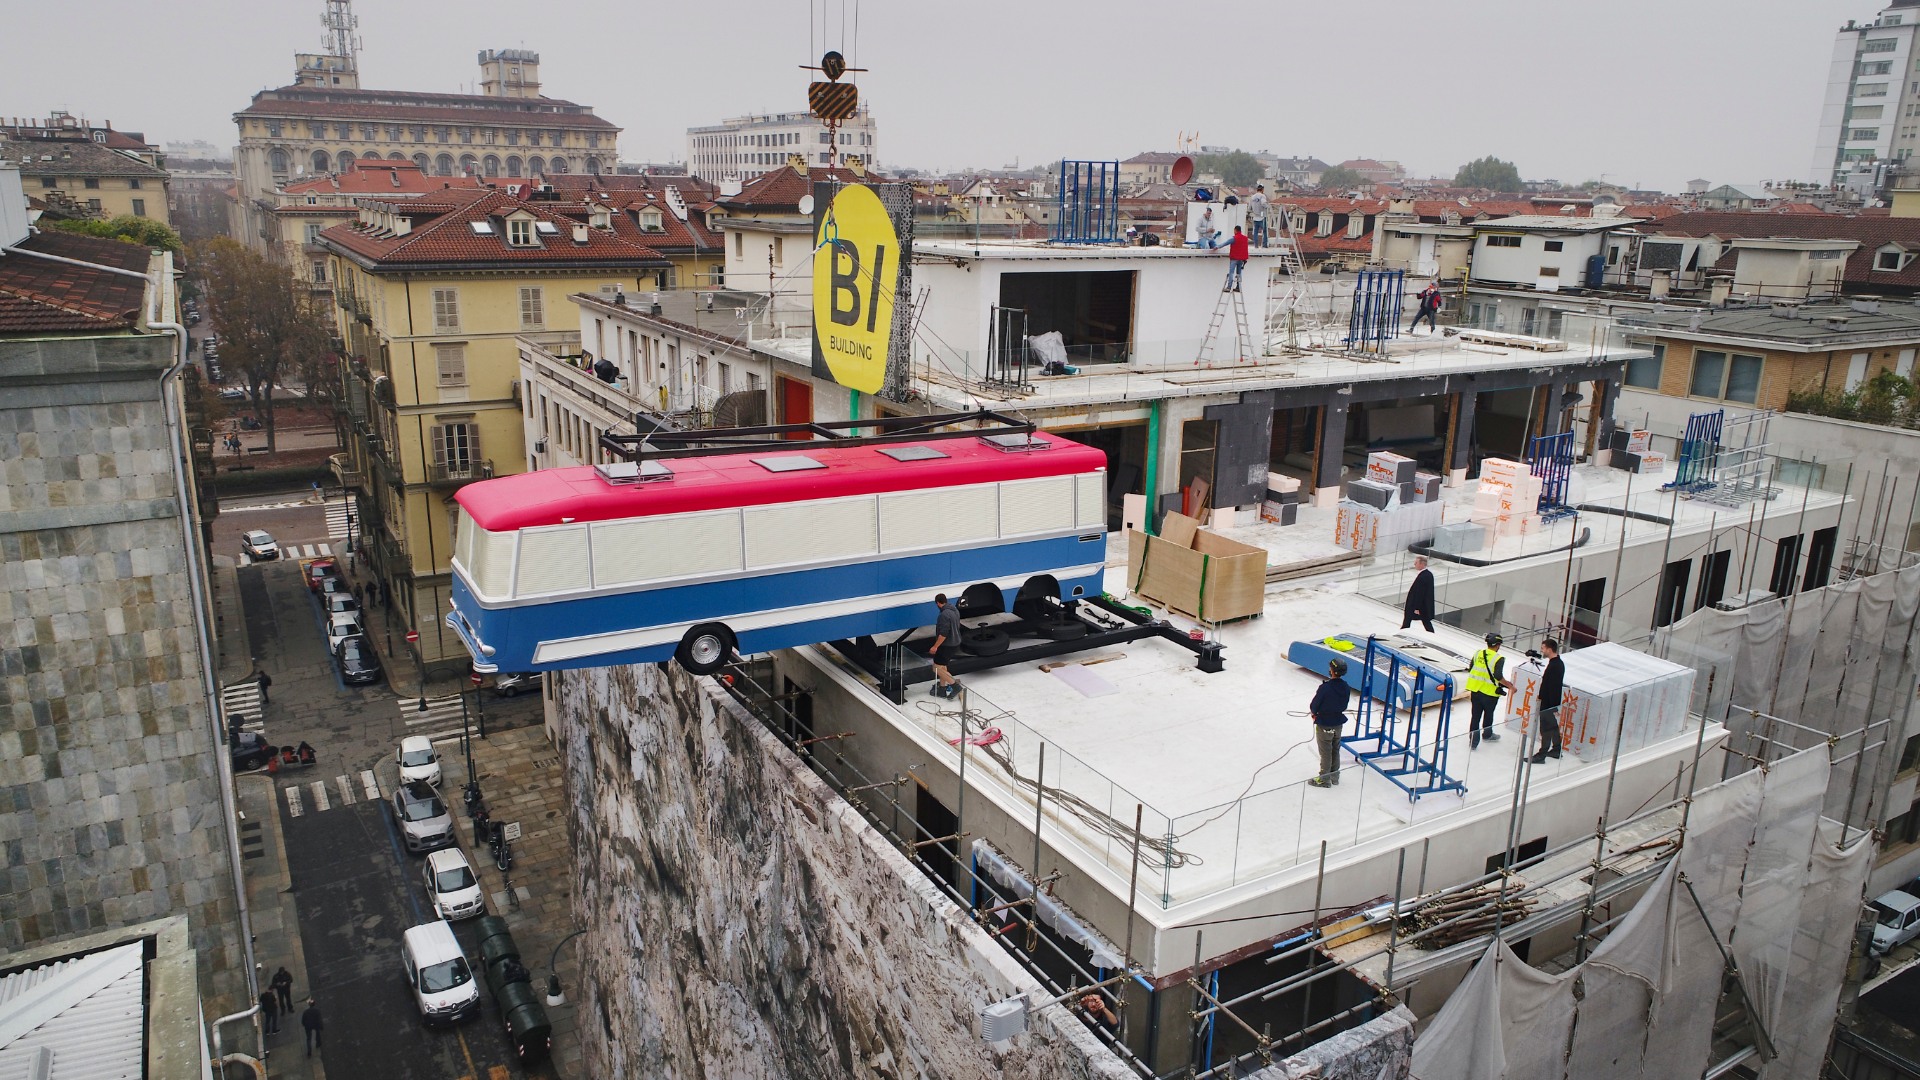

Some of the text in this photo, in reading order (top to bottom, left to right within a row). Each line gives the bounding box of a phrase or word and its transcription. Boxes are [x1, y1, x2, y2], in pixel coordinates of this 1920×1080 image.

[830, 238, 885, 333] BI
[830, 335, 873, 361] BUILDING
[1515, 677, 1537, 735] RÖFIX
